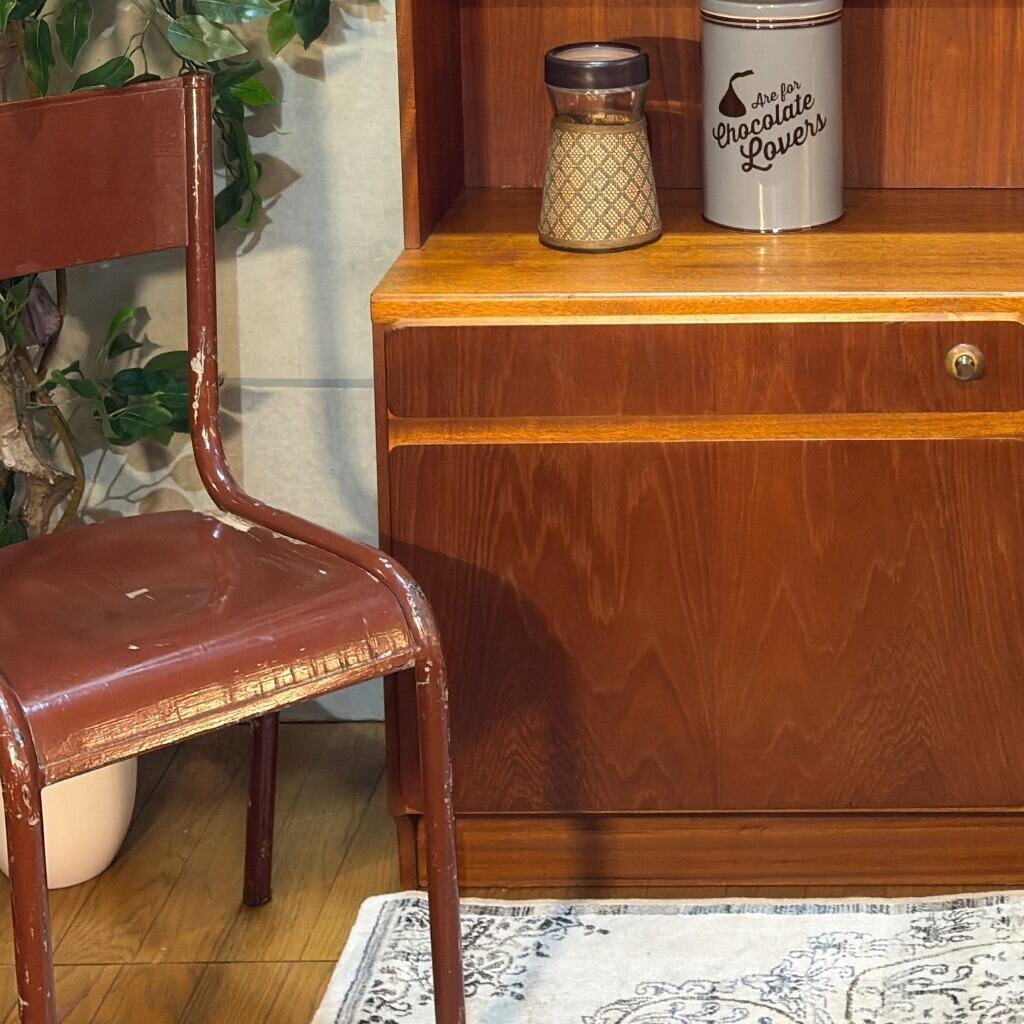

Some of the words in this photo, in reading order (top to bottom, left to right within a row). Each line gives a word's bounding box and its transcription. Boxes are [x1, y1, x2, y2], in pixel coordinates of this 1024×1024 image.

[712, 94, 815, 148] Chocolate
[751, 91, 778, 109] Are
[780, 80, 801, 102] for
[740, 113, 826, 172] Lovers
